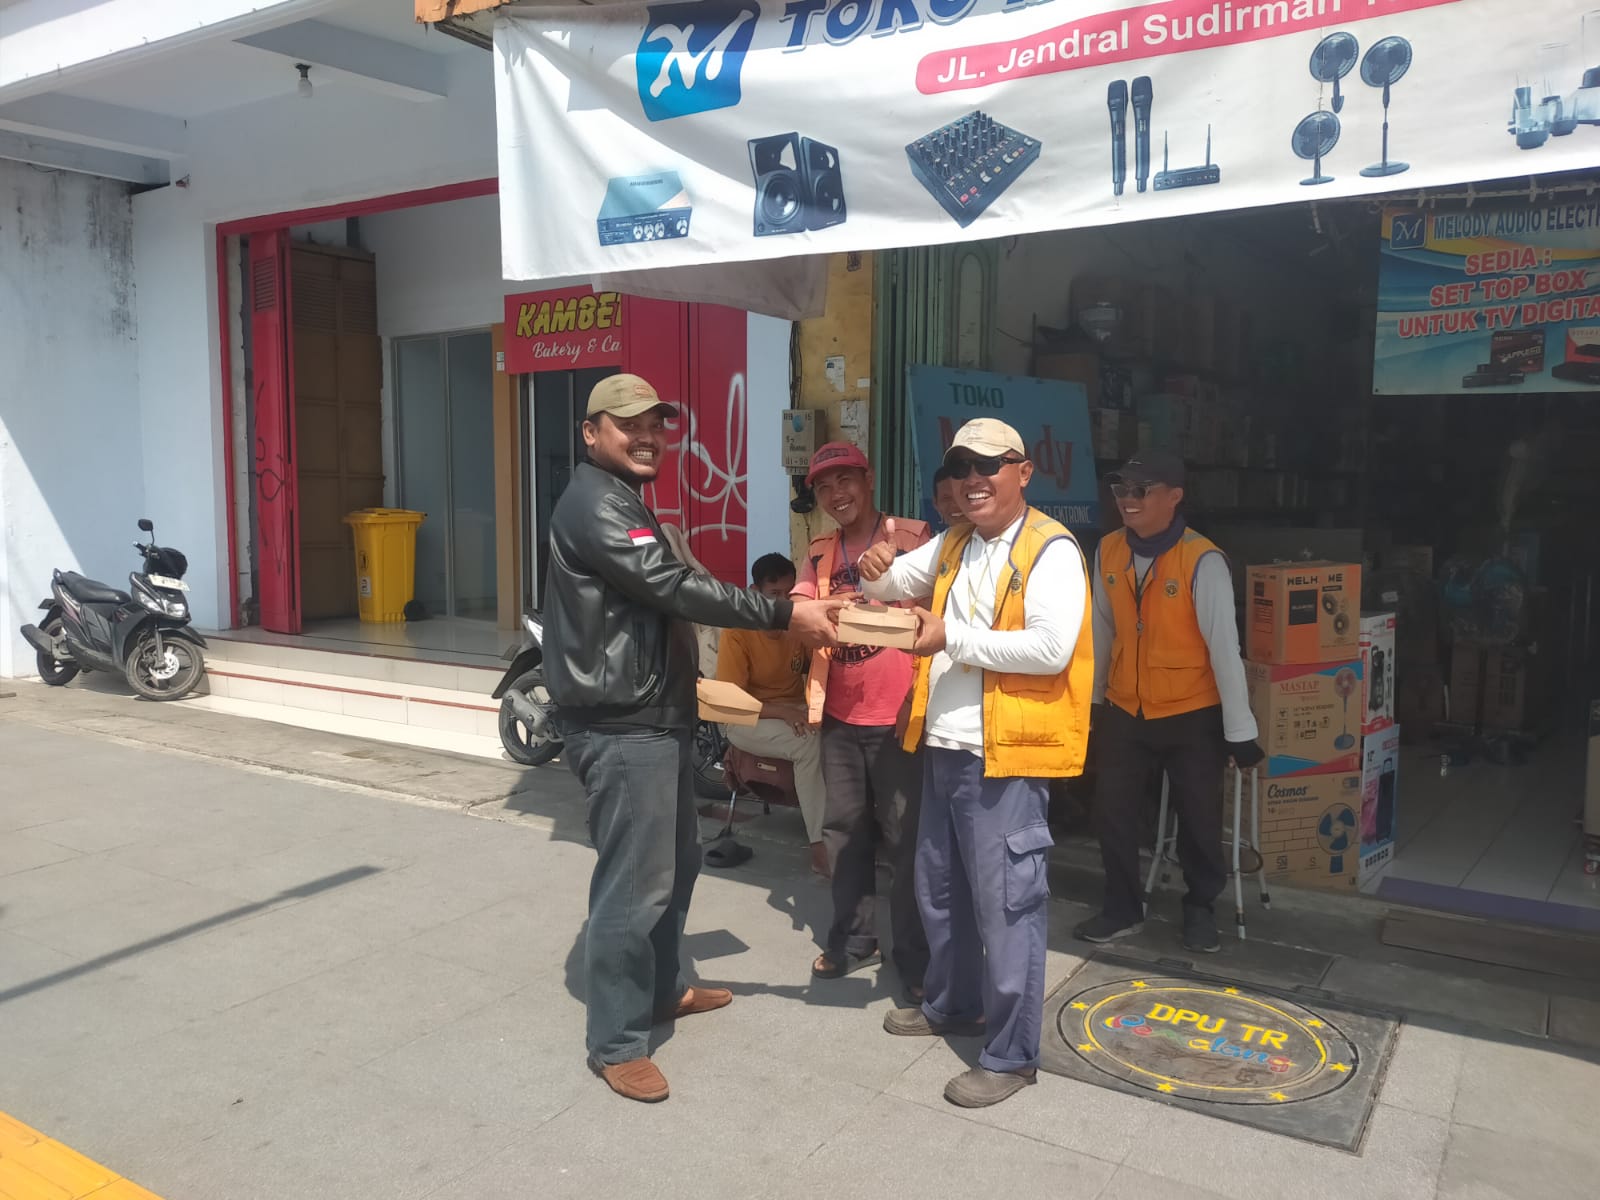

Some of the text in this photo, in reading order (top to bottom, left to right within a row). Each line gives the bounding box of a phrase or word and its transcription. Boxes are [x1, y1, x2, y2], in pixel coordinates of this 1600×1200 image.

[937, 56, 986, 84] JL.
[997, 20, 1129, 74] Jendral
[1433, 212, 1492, 241] MELODY
[1494, 206, 1542, 236] AUDIO
[1464, 246, 1538, 277] SEDIA
[1430, 268, 1588, 308] SET TOP BOX
[1398, 309, 1478, 339] UNTUK
[1484, 304, 1517, 329] TV
[532, 341, 582, 364] Bakery
[587, 337, 598, 353] &
[949, 382, 1005, 409] TOKO
[1267, 783, 1308, 799] Cosmos
[1145, 1002, 1292, 1051] DPU TR
